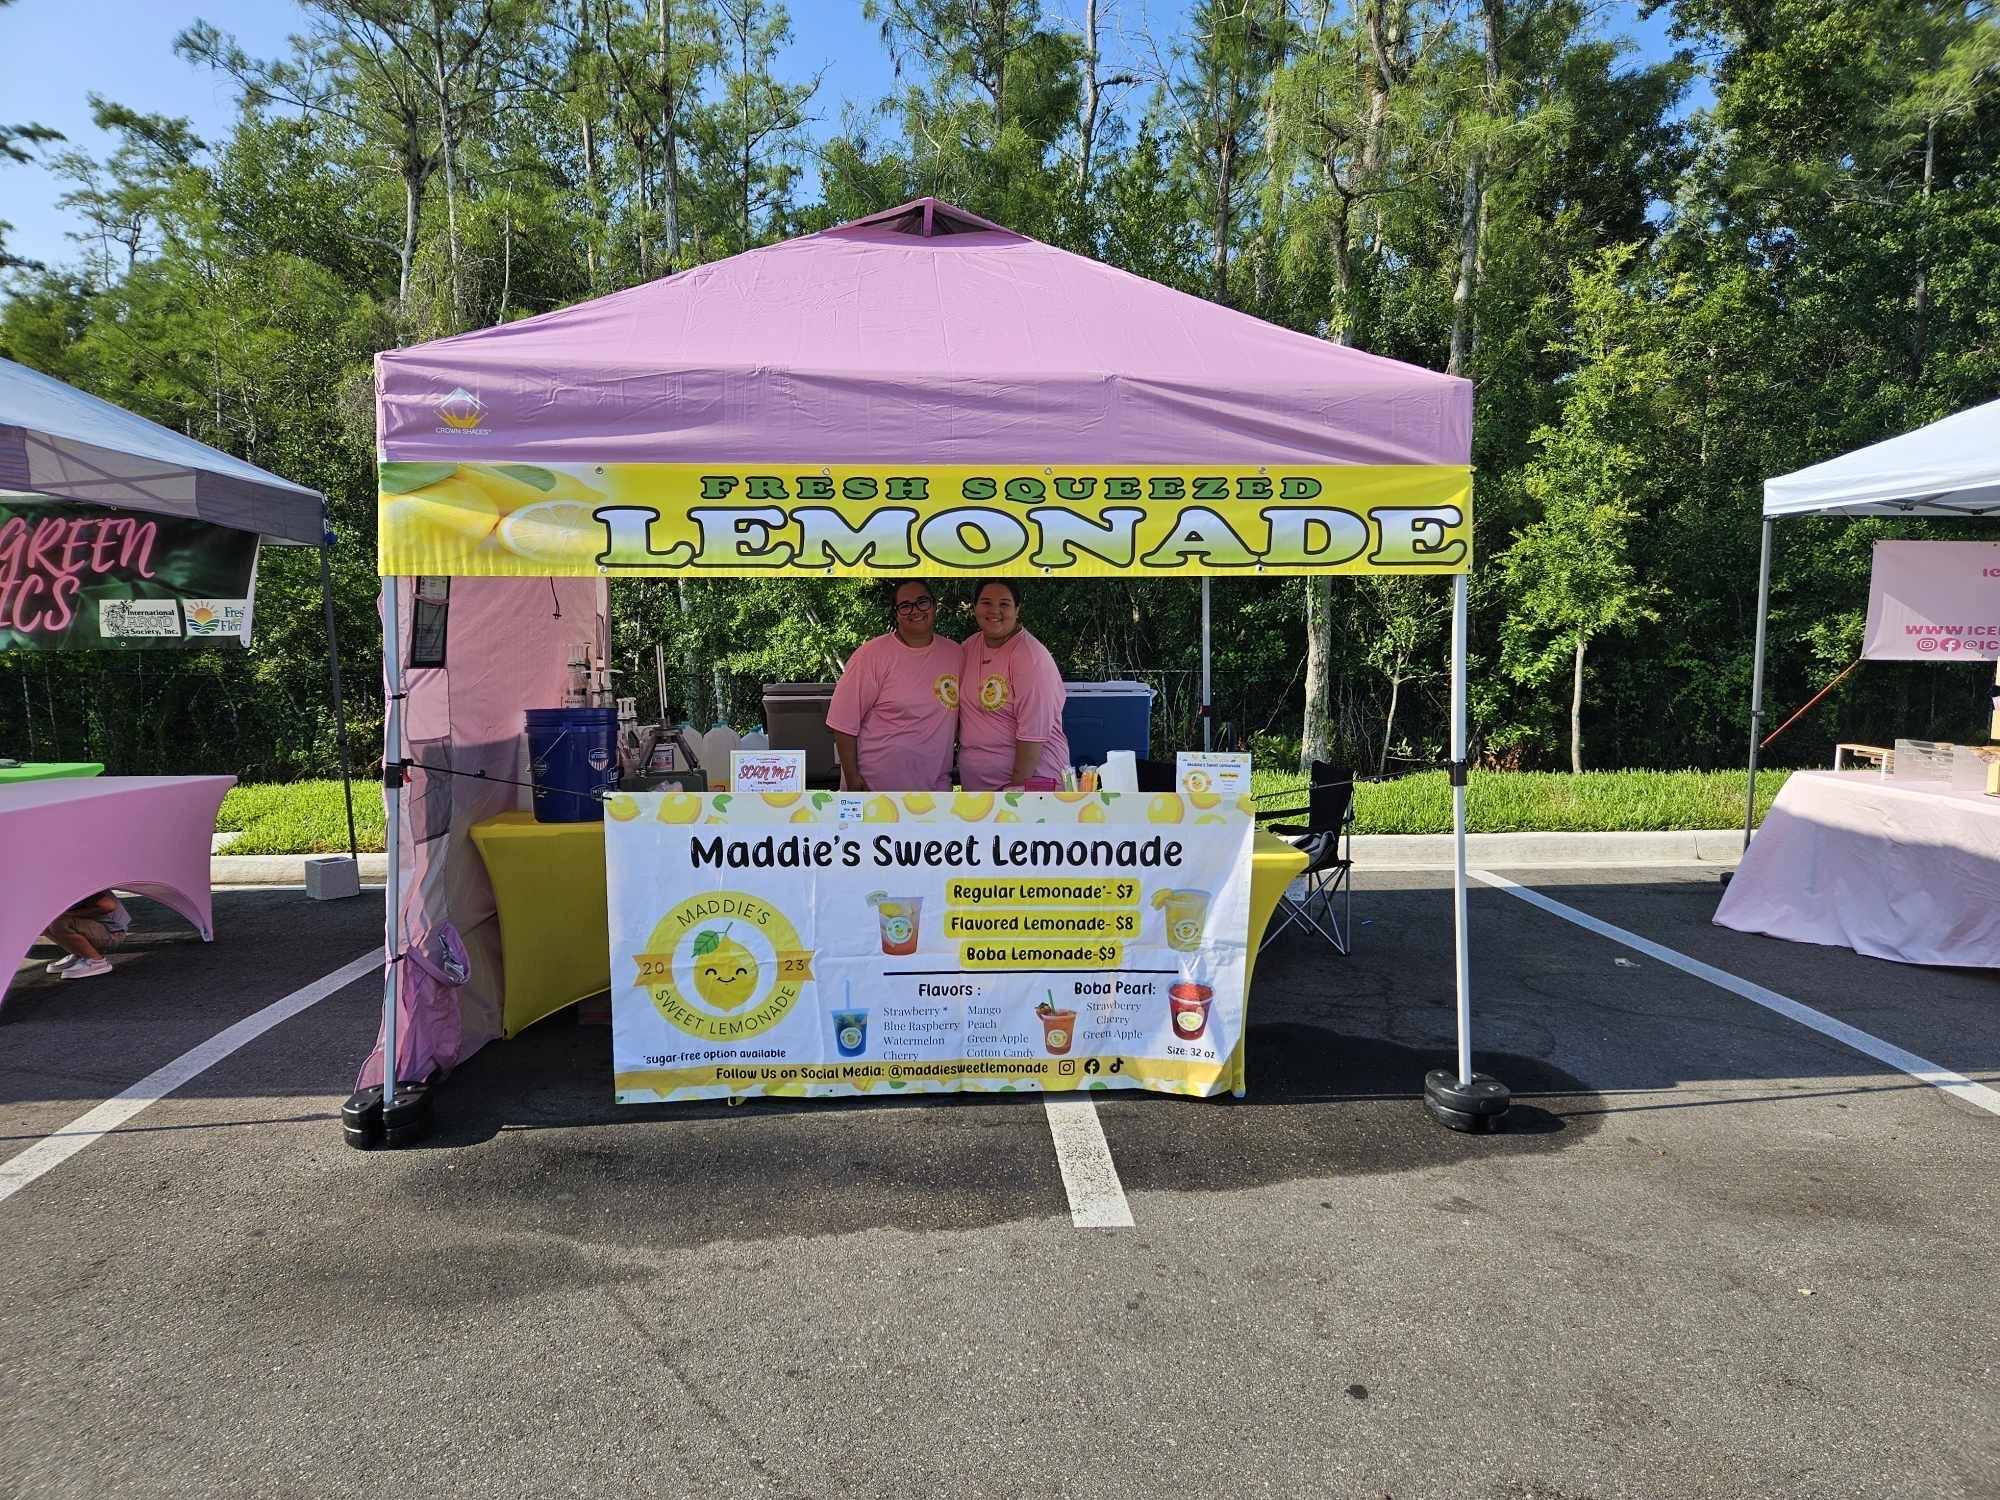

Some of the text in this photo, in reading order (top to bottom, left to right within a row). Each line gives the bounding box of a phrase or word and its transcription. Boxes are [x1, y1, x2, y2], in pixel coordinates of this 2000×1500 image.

[700, 476, 1322, 503] FRESH SQUEEZED
[593, 506, 1467, 568] LEMONADE
[223, 606, 245, 618] Fres
[691, 834, 1183, 868] Maddie's Sweet Lemonade
[953, 885, 1015, 903] Regular
[1116, 884, 1134, 899] $7
[676, 900, 771, 927] MADDIE'S
[951, 916, 1019, 931] Flavored
[1115, 915, 1134, 932] $8
[966, 947, 1006, 961] Boba
[643, 959, 804, 976] 20 23
[918, 983, 973, 997] Flavors
[1074, 981, 1156, 996] Boba Pearl:
[655, 986, 796, 1035] SWEET LEMONADE
[883, 1006, 940, 1018] Strawberry
[967, 1006, 1001, 1016] Mango
[1086, 1000, 1141, 1012] Strawberry
[883, 1021, 960, 1032] Blue Raspberry
[967, 1020, 997, 1029] Peach
[1096, 1015, 1130, 1026] Cherry
[883, 1036, 945, 1046] Watermelon
[966, 1034, 1029, 1045] Green Apple
[1082, 1029, 1143, 1041] Green Apple
[703, 1049, 737, 1061] option
[739, 1048, 786, 1059] available
[883, 1051, 919, 1062] Cherry
[966, 1048, 1036, 1060] Cotton Candy
[1167, 1045, 1215, 1059] Size: 32 oz
[716, 1062, 1049, 1080] Follow Us on Social Media: @maddiesweetlemonade
